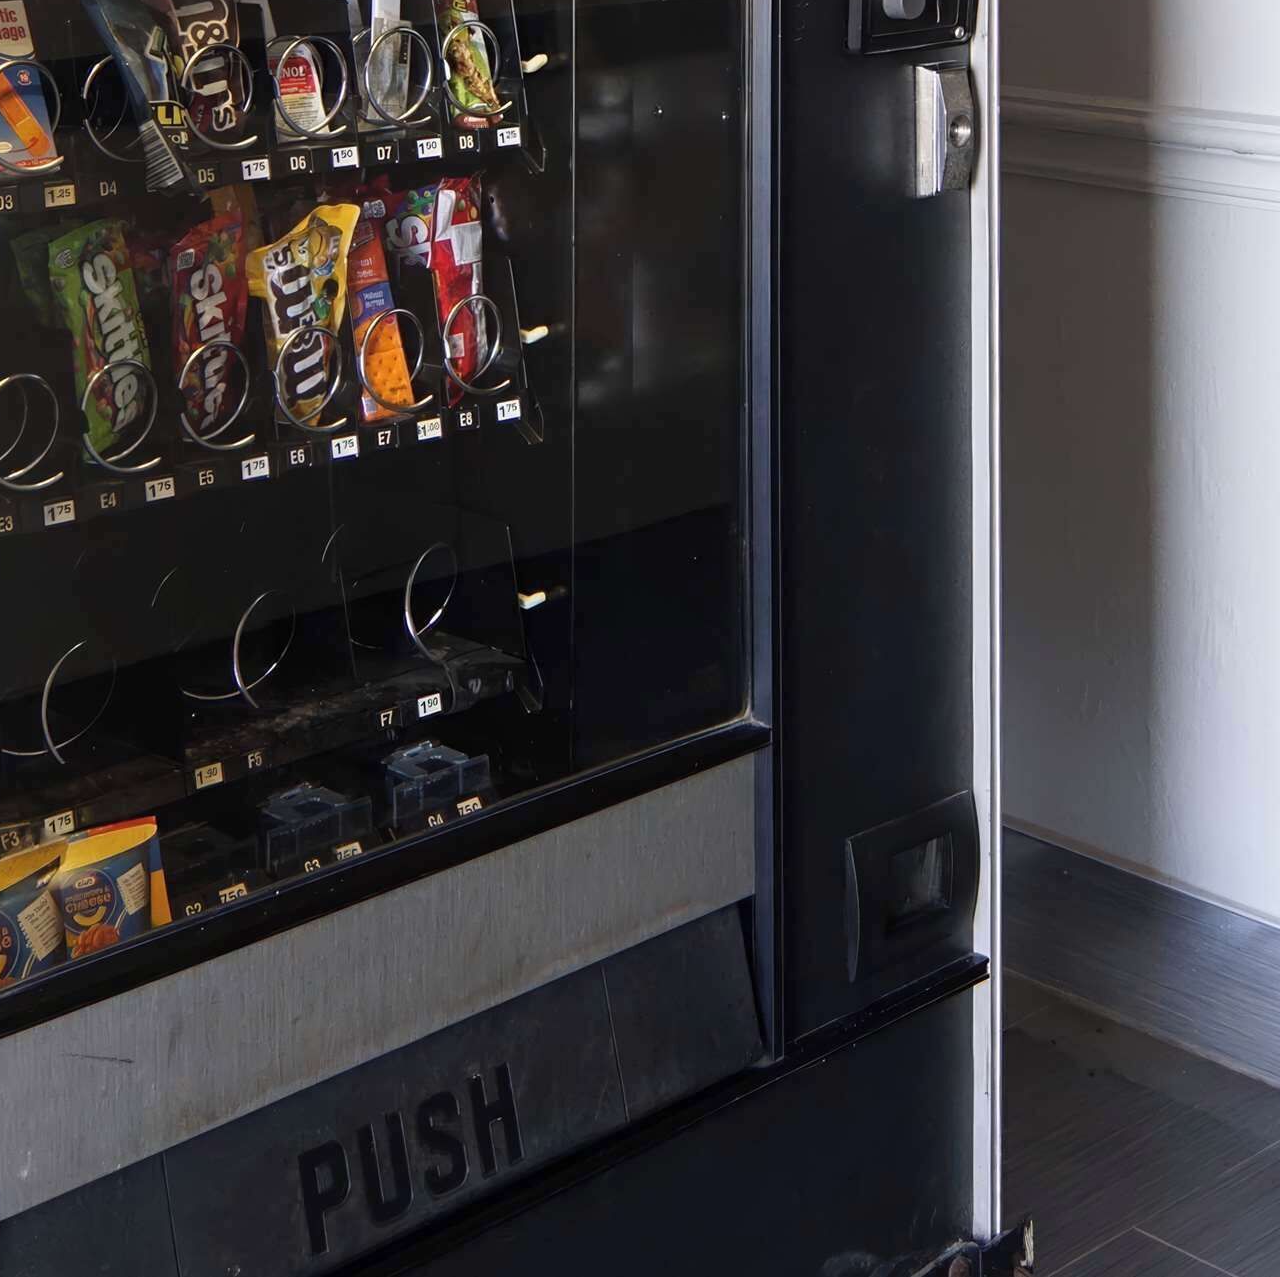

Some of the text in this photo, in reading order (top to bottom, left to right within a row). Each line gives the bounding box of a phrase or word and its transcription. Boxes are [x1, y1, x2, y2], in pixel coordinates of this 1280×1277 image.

[459, 136, 474, 149] D8
[376, 146, 392, 161] D7
[290, 156, 306, 170] D6
[198, 168, 215, 184] D5
[100, 181, 117, 197] D4
[82, 252, 138, 434] Skittles
[459, 411, 473, 427] E8
[377, 430, 391, 446] E7
[290, 448, 306, 465] E6
[199, 469, 214, 486] E5
[100, 492, 116, 509] E4
[380, 710, 393, 727] F7
[248, 753, 262, 769] F5
[0, 831, 20, 850] F3
[298, 1062, 525, 1254] PUSH
